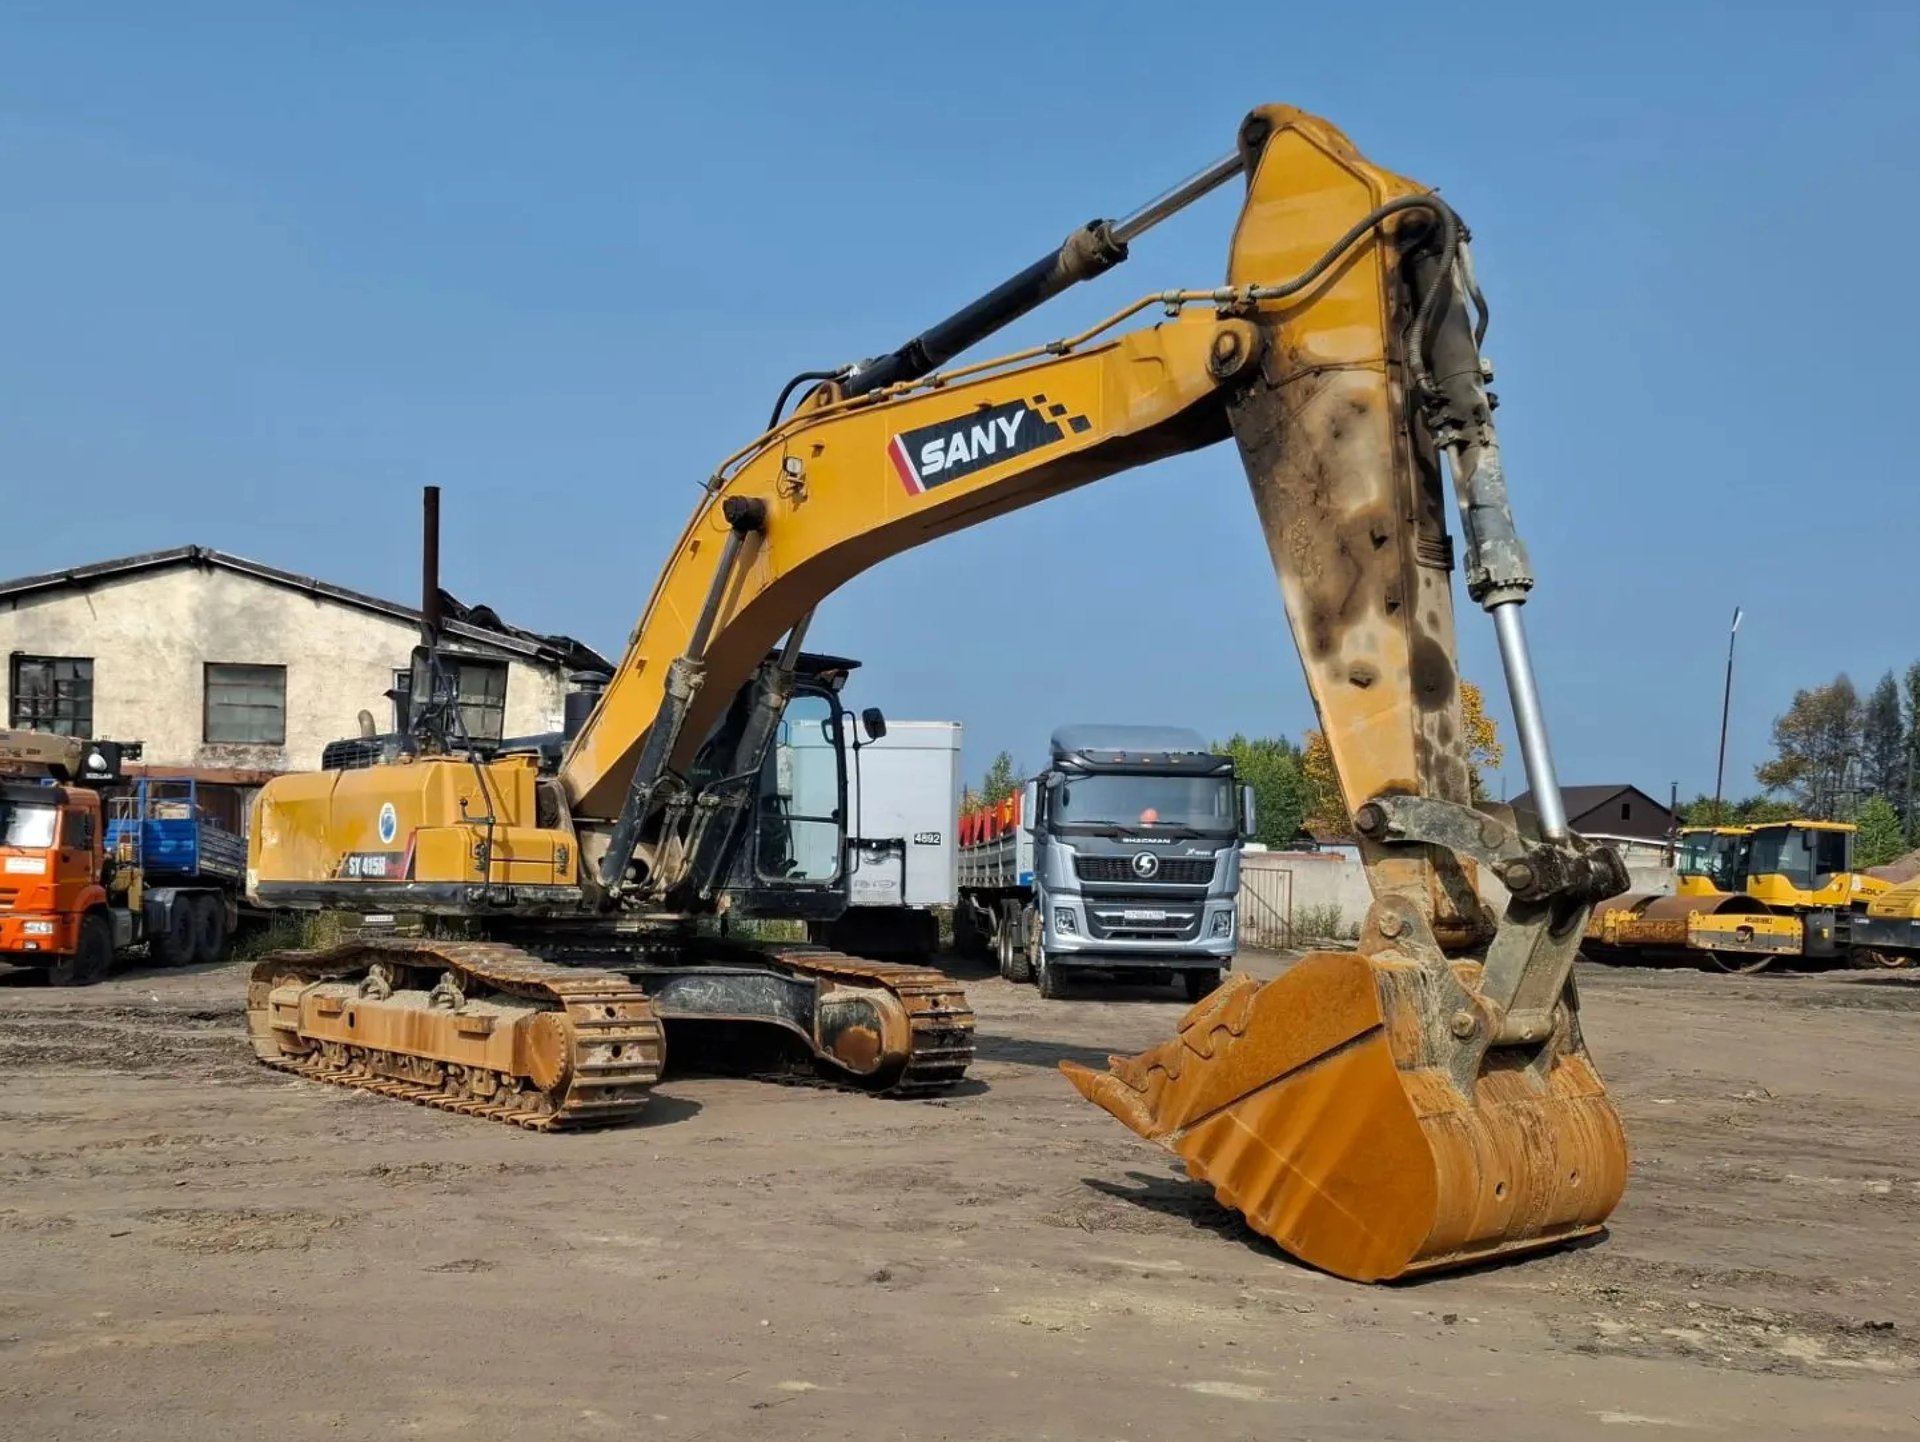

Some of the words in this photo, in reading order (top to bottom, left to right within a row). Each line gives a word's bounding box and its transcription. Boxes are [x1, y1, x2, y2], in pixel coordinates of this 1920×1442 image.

[921, 409, 1026, 476] SANY
[915, 833, 940, 844] 4892
[348, 856, 361, 875] SY
